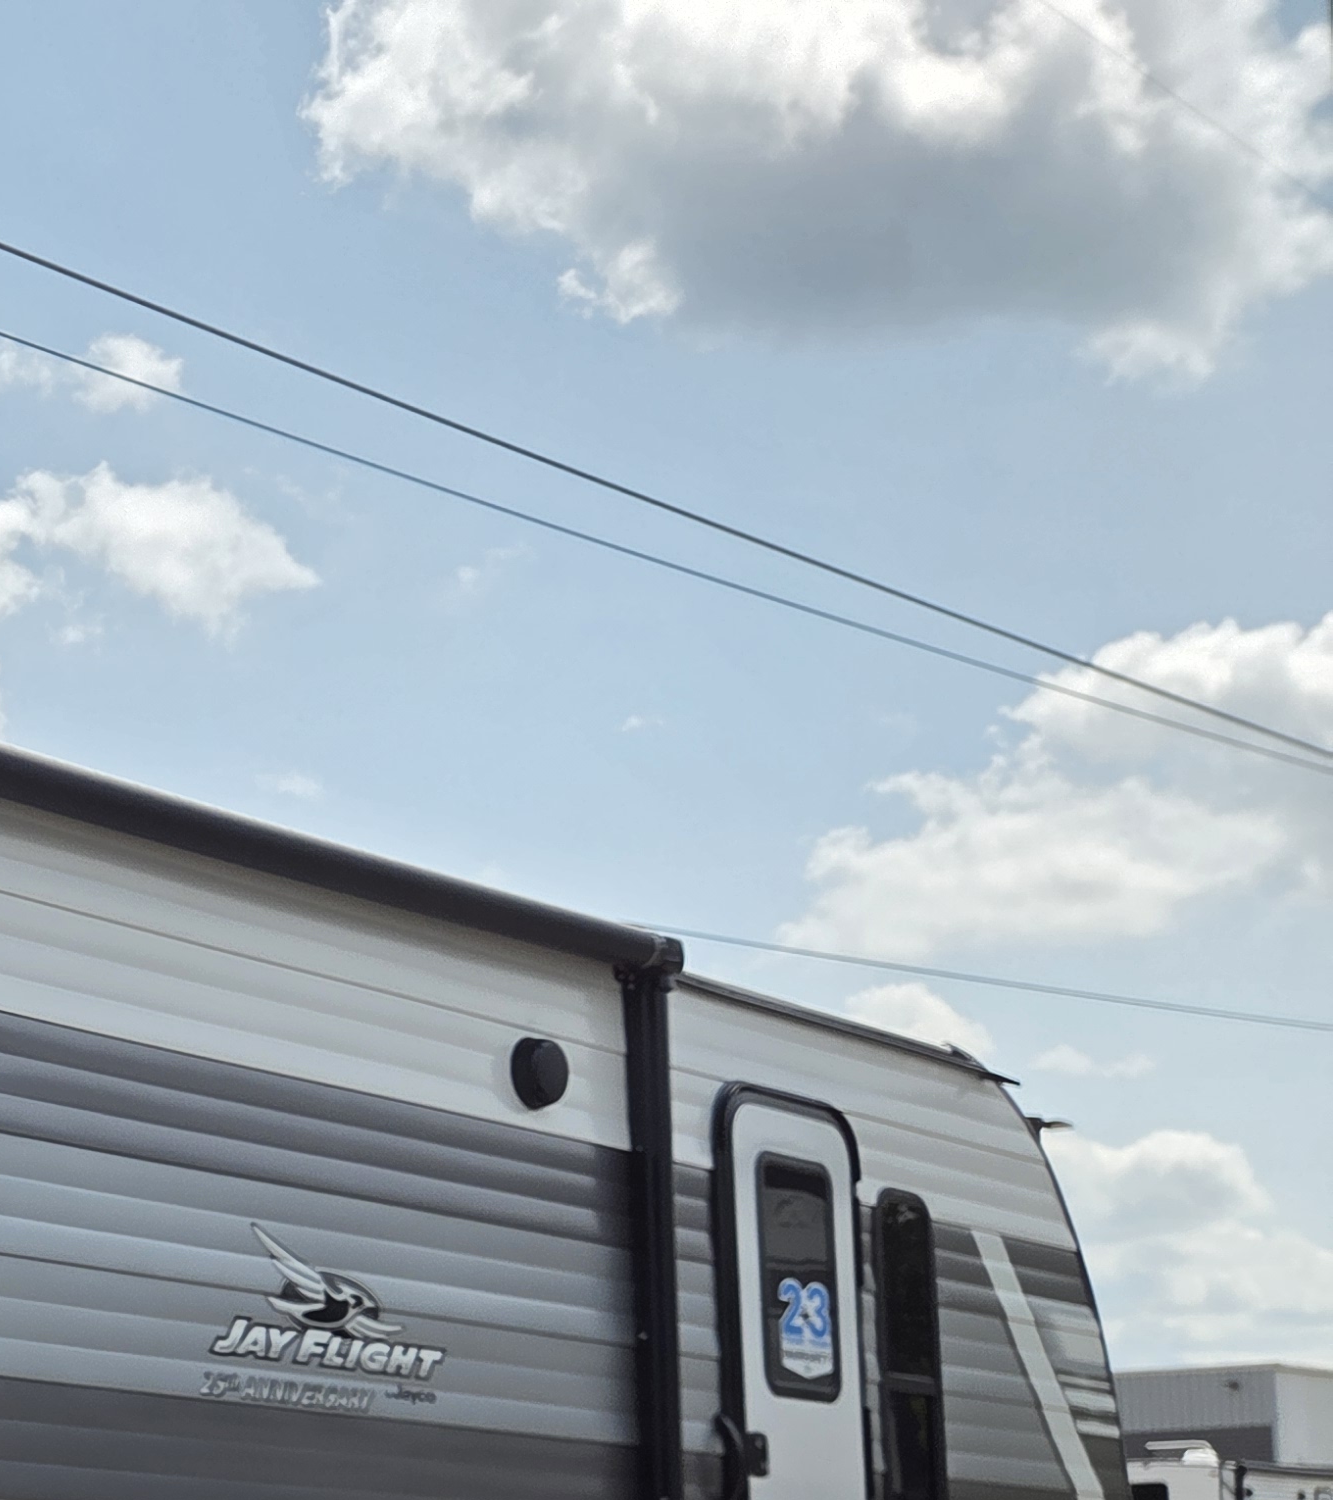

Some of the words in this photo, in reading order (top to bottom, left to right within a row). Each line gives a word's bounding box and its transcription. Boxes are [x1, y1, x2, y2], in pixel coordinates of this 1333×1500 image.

[781, 1283, 829, 1338] 23
[211, 1316, 299, 1361] JAY
[293, 1328, 446, 1380] FLIGHT
